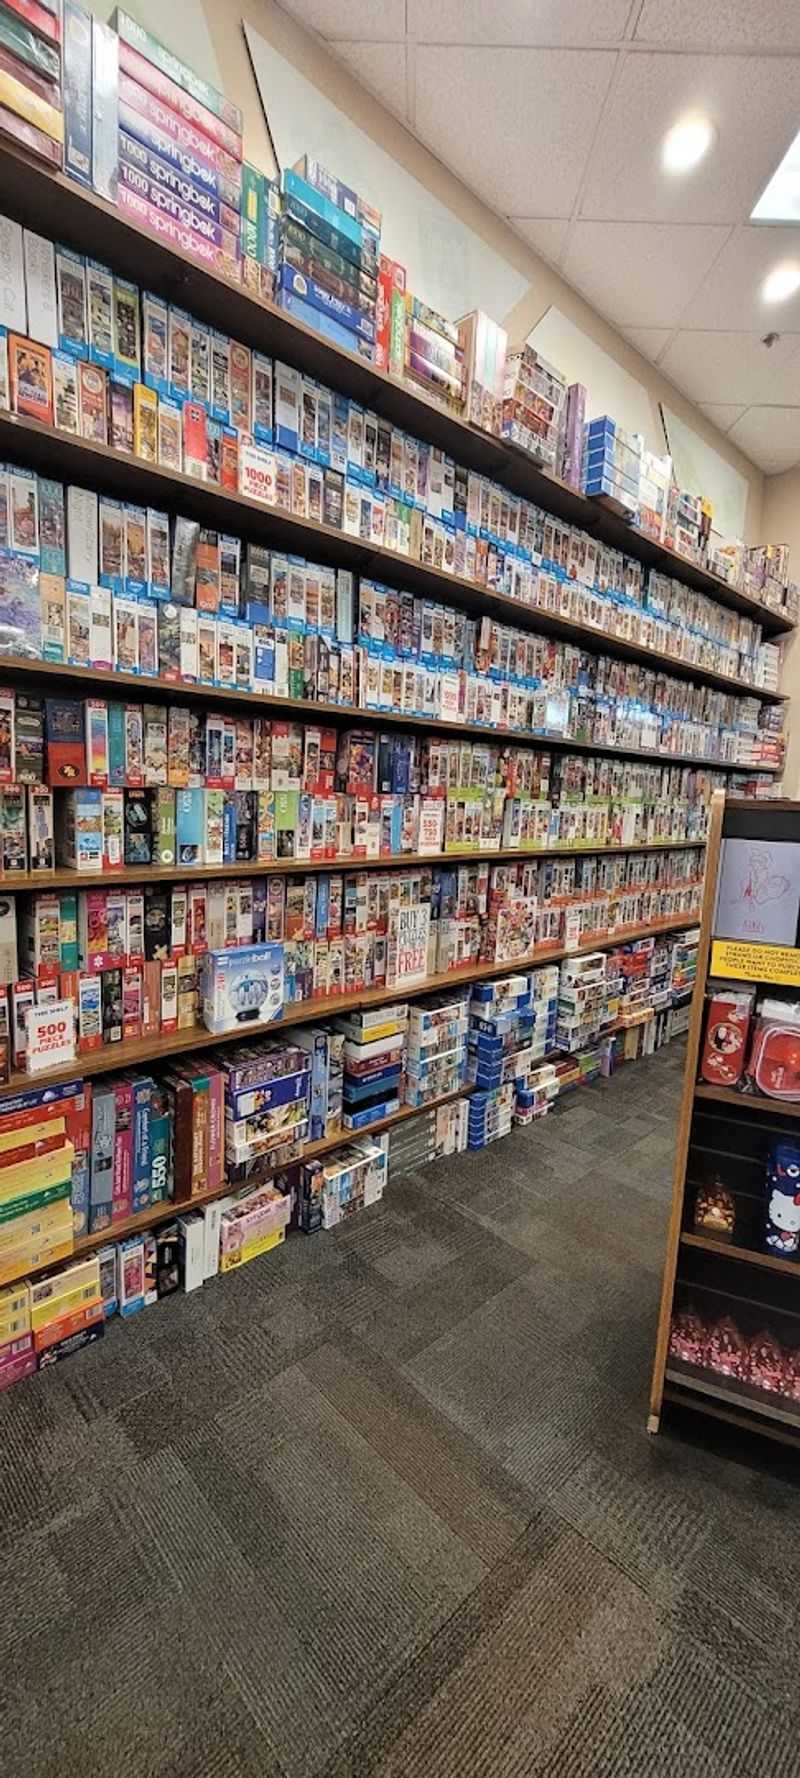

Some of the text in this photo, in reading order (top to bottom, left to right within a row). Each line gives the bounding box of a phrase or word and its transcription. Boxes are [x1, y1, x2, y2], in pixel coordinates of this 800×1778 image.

[120, 135, 216, 216] 1000 springbok
[150, 129, 216, 188] springbok
[121, 166, 216, 241] 1000 springbok
[120, 190, 215, 261] 1000 springbok
[245, 467, 272, 486] 1000
[399, 948, 425, 973] FREE
[37, 1021, 66, 1038] 500
[39, 1034, 63, 1045] PIECE
[152, 1155, 167, 1189] 550
